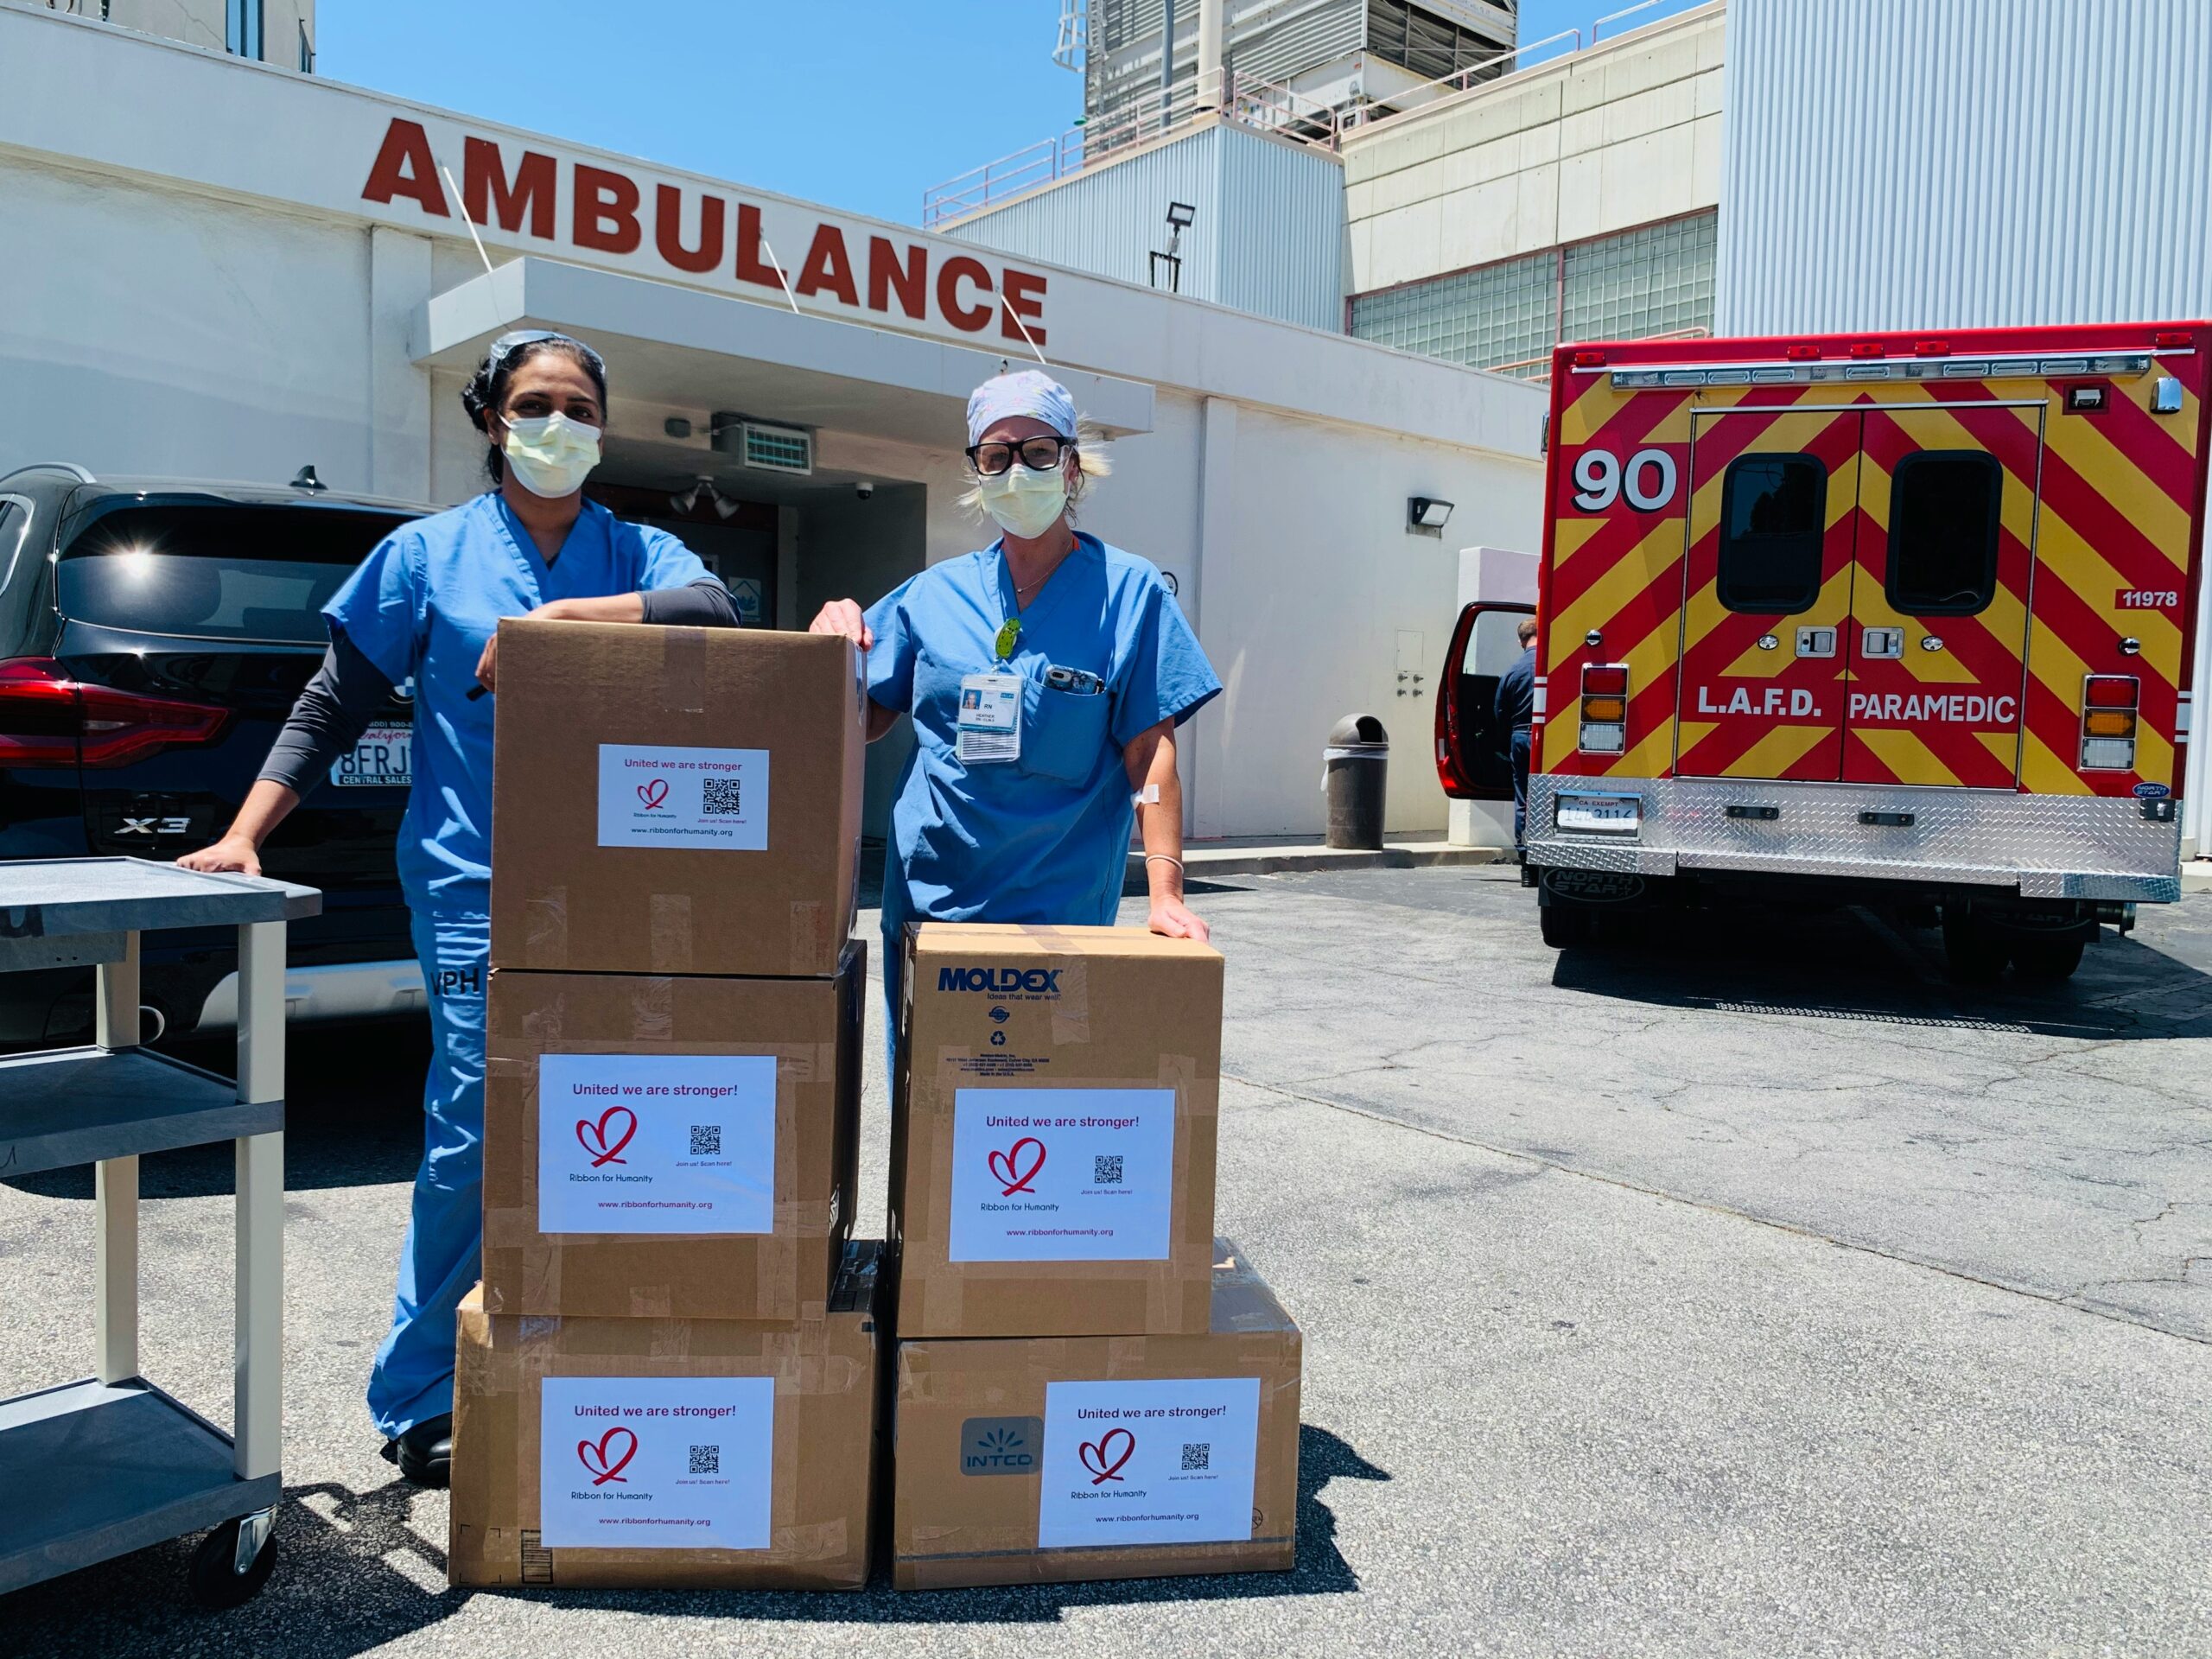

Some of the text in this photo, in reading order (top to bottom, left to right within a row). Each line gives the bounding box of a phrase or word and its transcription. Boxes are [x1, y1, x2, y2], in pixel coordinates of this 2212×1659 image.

[361, 118, 1047, 347] AMBULANCE
[1571, 448, 1677, 513] 90
[2122, 590, 2178, 607] 11978
[1697, 685, 2016, 724] L.A.F.D. PARAMEDIC
[340, 745, 412, 774] 8FRJ
[624, 759, 658, 768] United
[677, 761, 696, 770] are
[697, 760, 743, 772] stronger
[113, 817, 191, 834] X3
[631, 827, 733, 836] www.ribbonforhumanity.org
[938, 967, 1060, 993] MOLDEX
[572, 1083, 738, 1098] United we are stronger!
[985, 1116, 1140, 1130] United we are stronger!
[569, 1173, 653, 1184] Ribbon for Humanity
[597, 1199, 714, 1210] www.ribbonforhumanity.org
[980, 1202, 1059, 1212] Ribbon for Humanity
[1006, 1228, 1114, 1237] www.ribbonforhumanity.org
[574, 1404, 736, 1420] United we are stronger!
[1077, 1405, 1227, 1420] United we are stronger!
[966, 1453, 1033, 1468] INTCO
[570, 1491, 653, 1501] Ribbon for Humanity
[1071, 1489, 1147, 1500] Ribbon for Humanity
[598, 1516, 711, 1527] www.ribbonforhumanity.org
[1095, 1512, 1200, 1523] www.ribbonforhumanity.org
